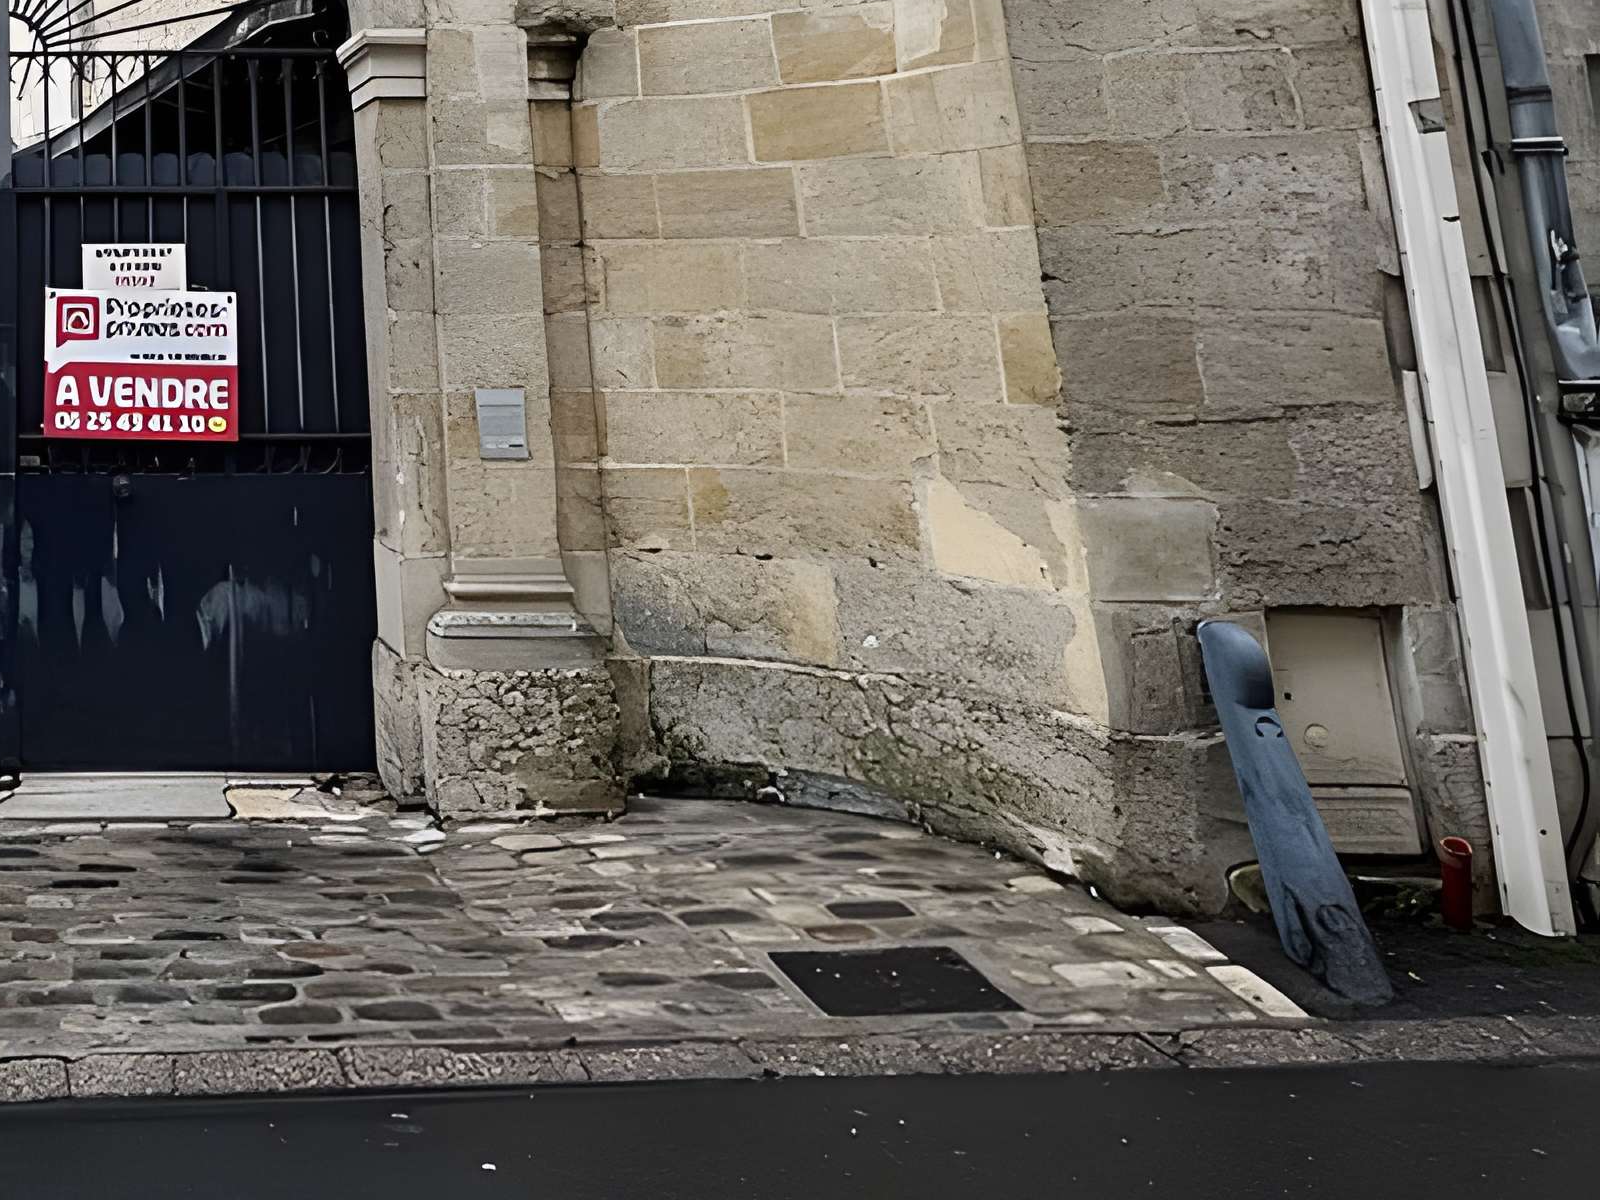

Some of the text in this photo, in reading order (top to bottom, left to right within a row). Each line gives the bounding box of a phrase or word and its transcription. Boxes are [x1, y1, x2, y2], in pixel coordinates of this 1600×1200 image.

[56, 375, 229, 410] A VENDRE
[178, 414, 205, 433] 10
